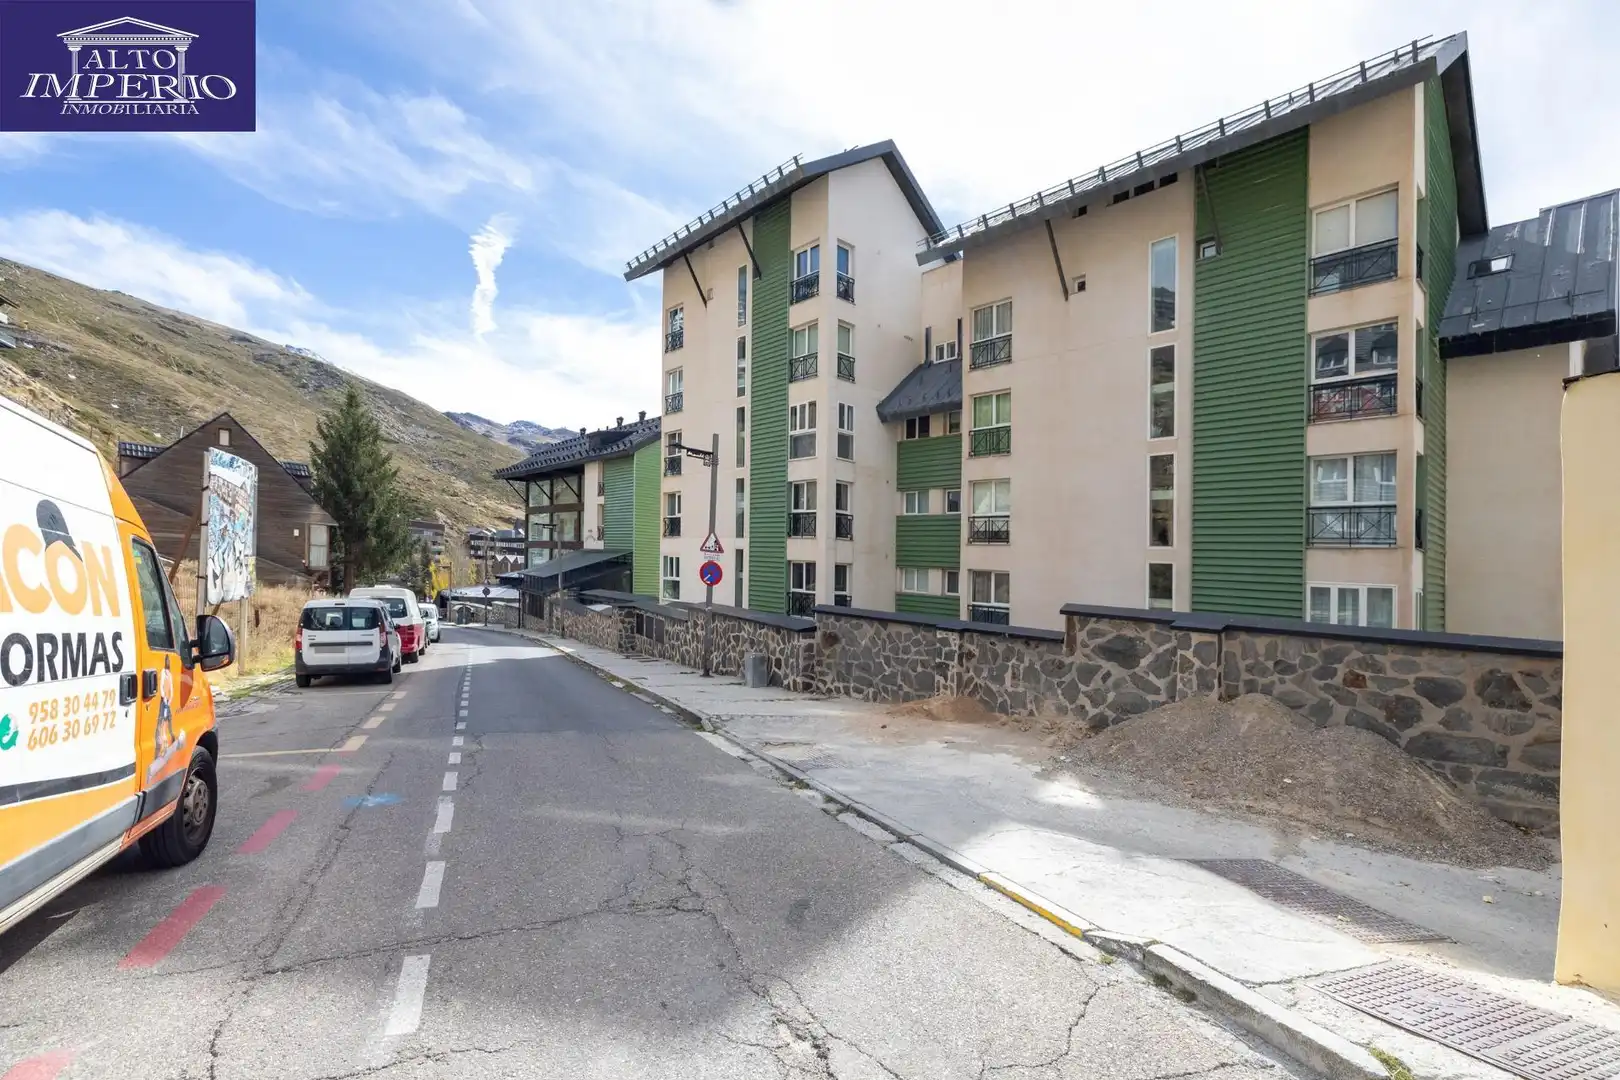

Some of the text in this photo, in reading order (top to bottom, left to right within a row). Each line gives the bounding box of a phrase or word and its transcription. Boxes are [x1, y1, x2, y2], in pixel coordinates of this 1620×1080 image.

[0, 523, 120, 617] CON
[29, 688, 116, 725] 958 30 44 79
[27, 710, 116, 751] 606 30 69 72
